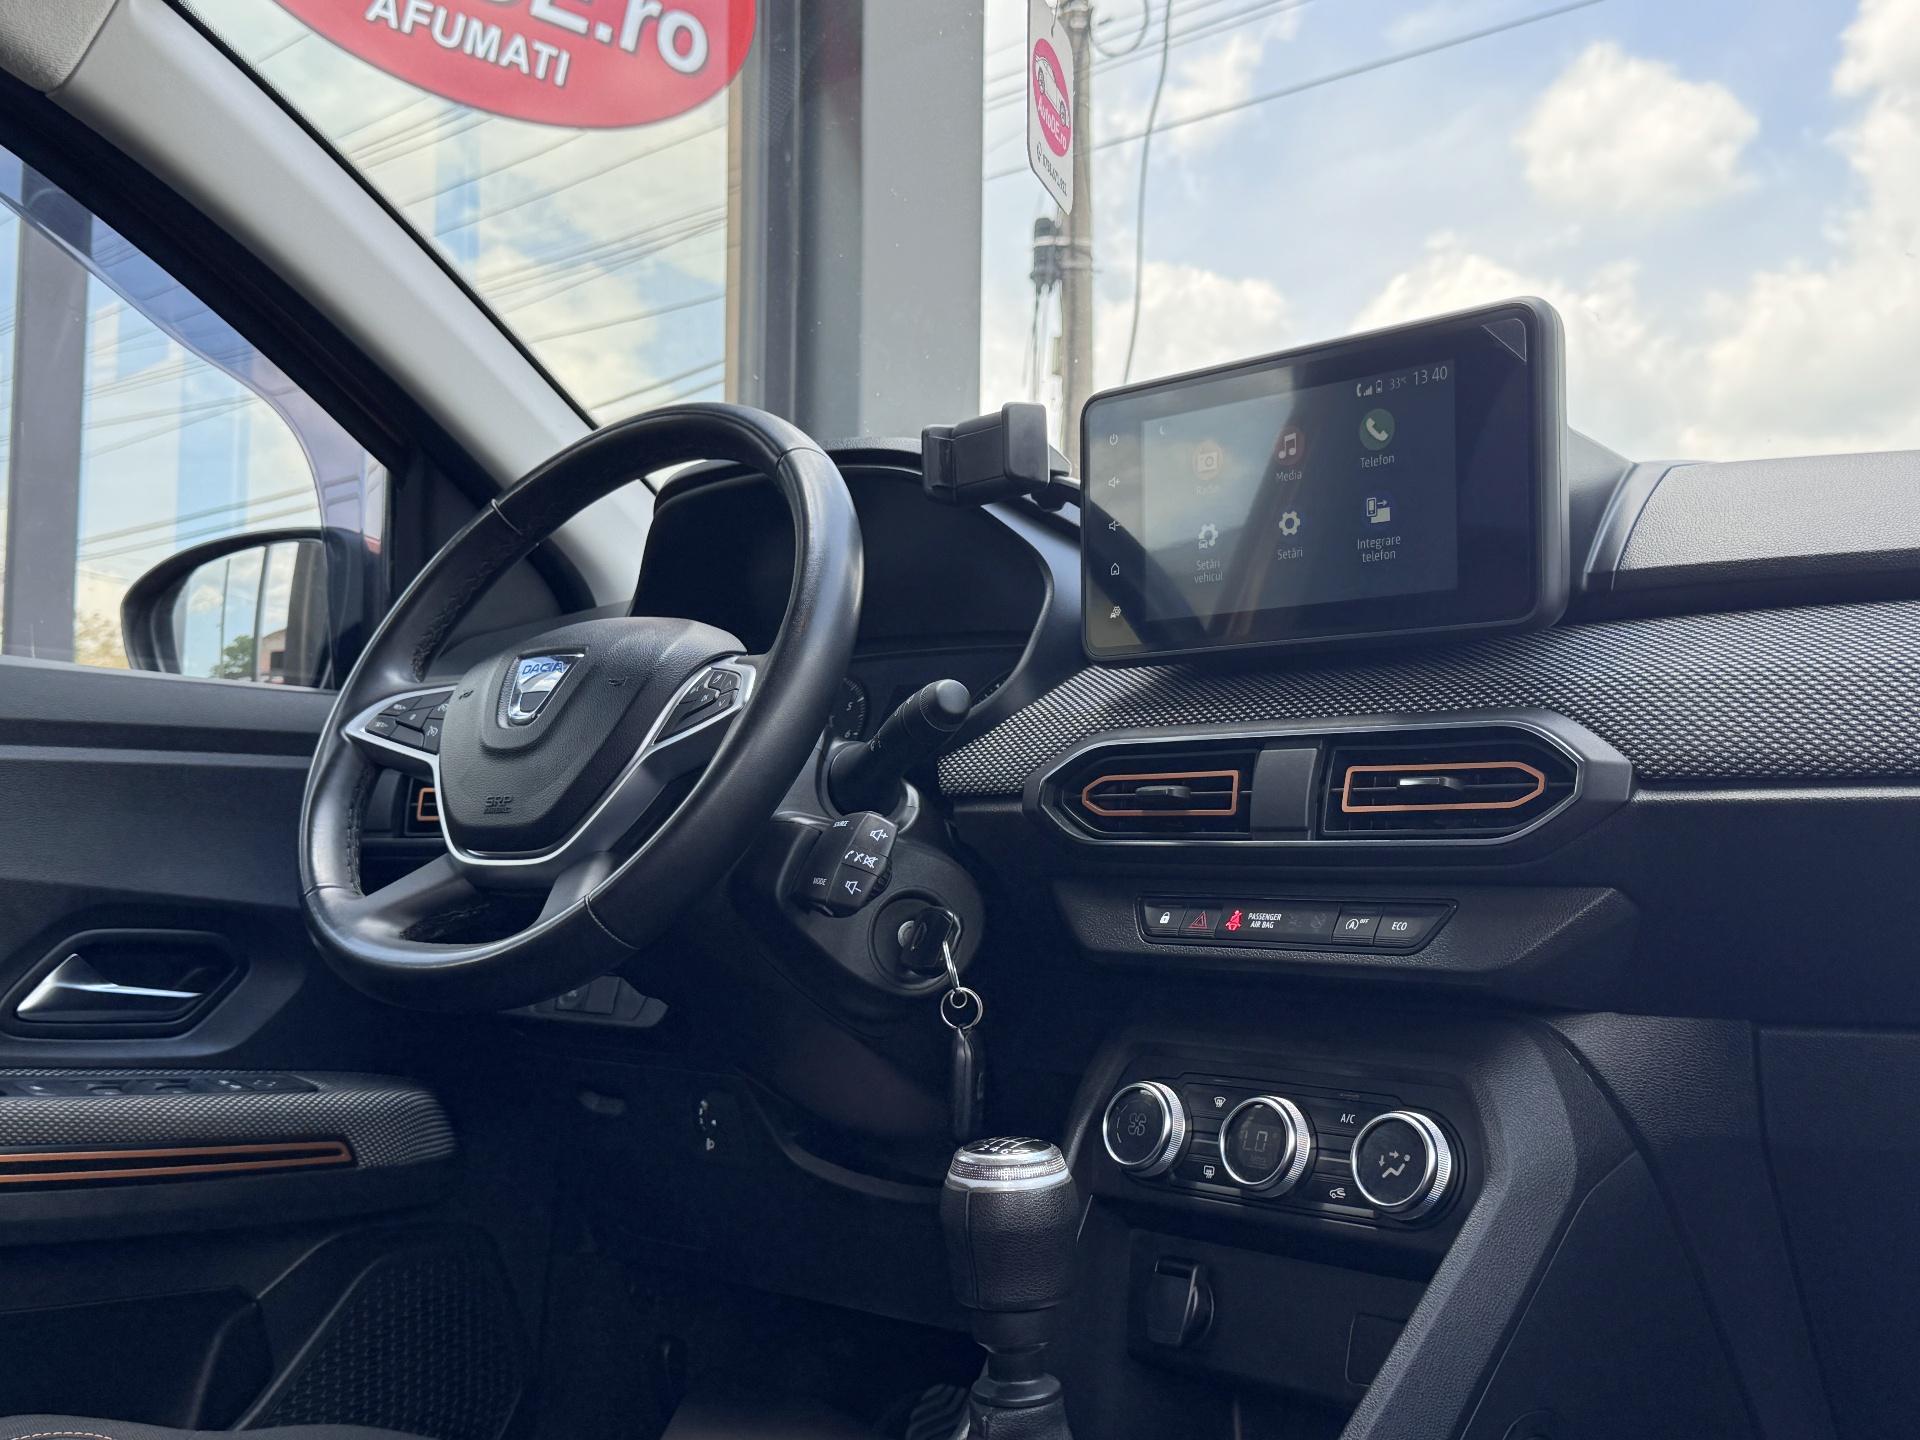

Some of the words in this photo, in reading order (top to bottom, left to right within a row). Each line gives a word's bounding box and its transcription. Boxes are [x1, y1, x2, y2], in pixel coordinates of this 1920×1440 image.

[364, 0, 570, 87] AFUMATI
[484, 0, 709, 74] .ro
[1360, 454, 1395, 469] Telefon
[1276, 470, 1302, 482] Media
[1357, 535, 1401, 550] Integrare
[1362, 549, 1396, 563] telefon
[1194, 571, 1223, 584] vehicul
[522, 662, 564, 675] DACIA
[1247, 912, 1282, 921] PASSENGER
[1250, 920, 1261, 929] AIR
[1261, 920, 1275, 929] BAG
[1391, 921, 1408, 931] ECO
[1340, 1113, 1356, 1124] A/C
